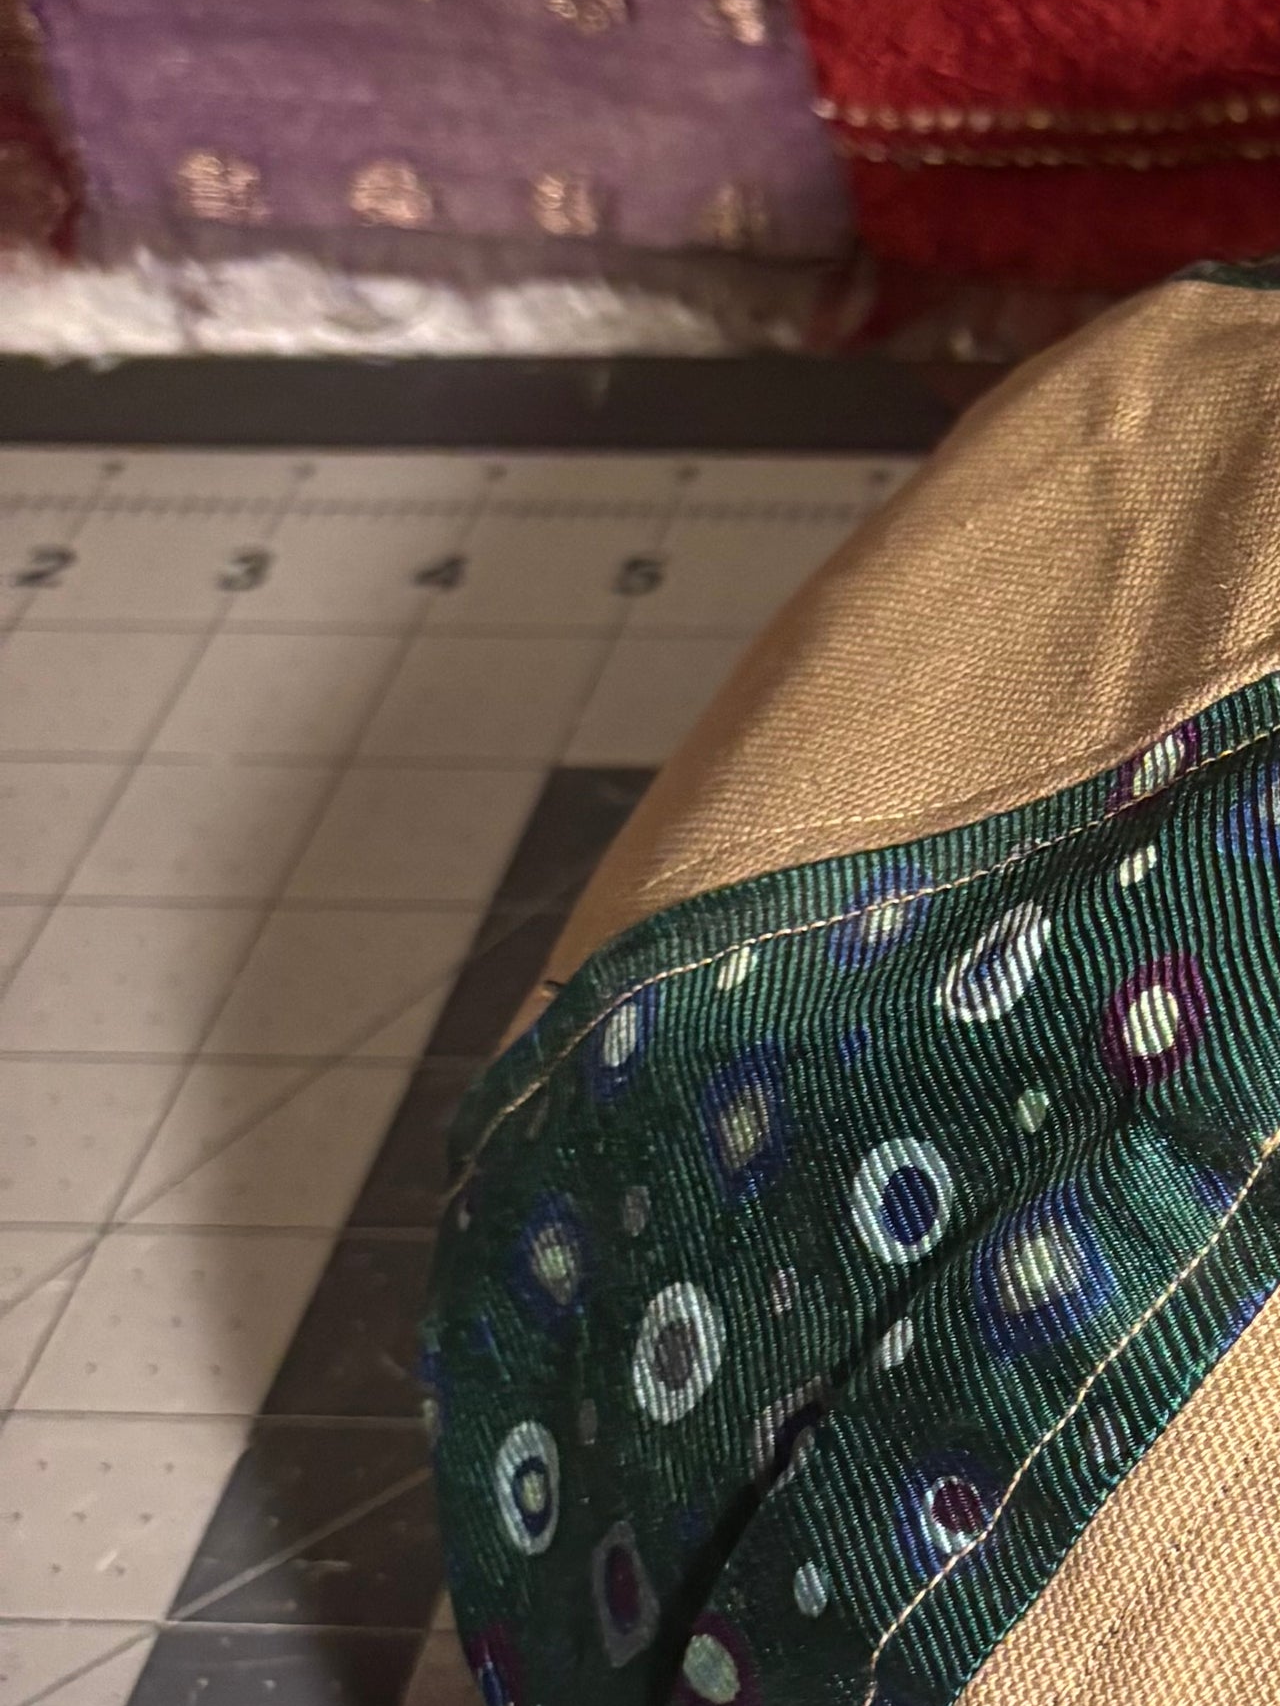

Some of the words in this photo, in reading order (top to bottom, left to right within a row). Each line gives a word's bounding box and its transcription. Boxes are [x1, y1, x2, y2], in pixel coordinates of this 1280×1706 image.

[8, 545, 77, 588] 2
[214, 545, 273, 593] 3
[412, 555, 468, 590] 4
